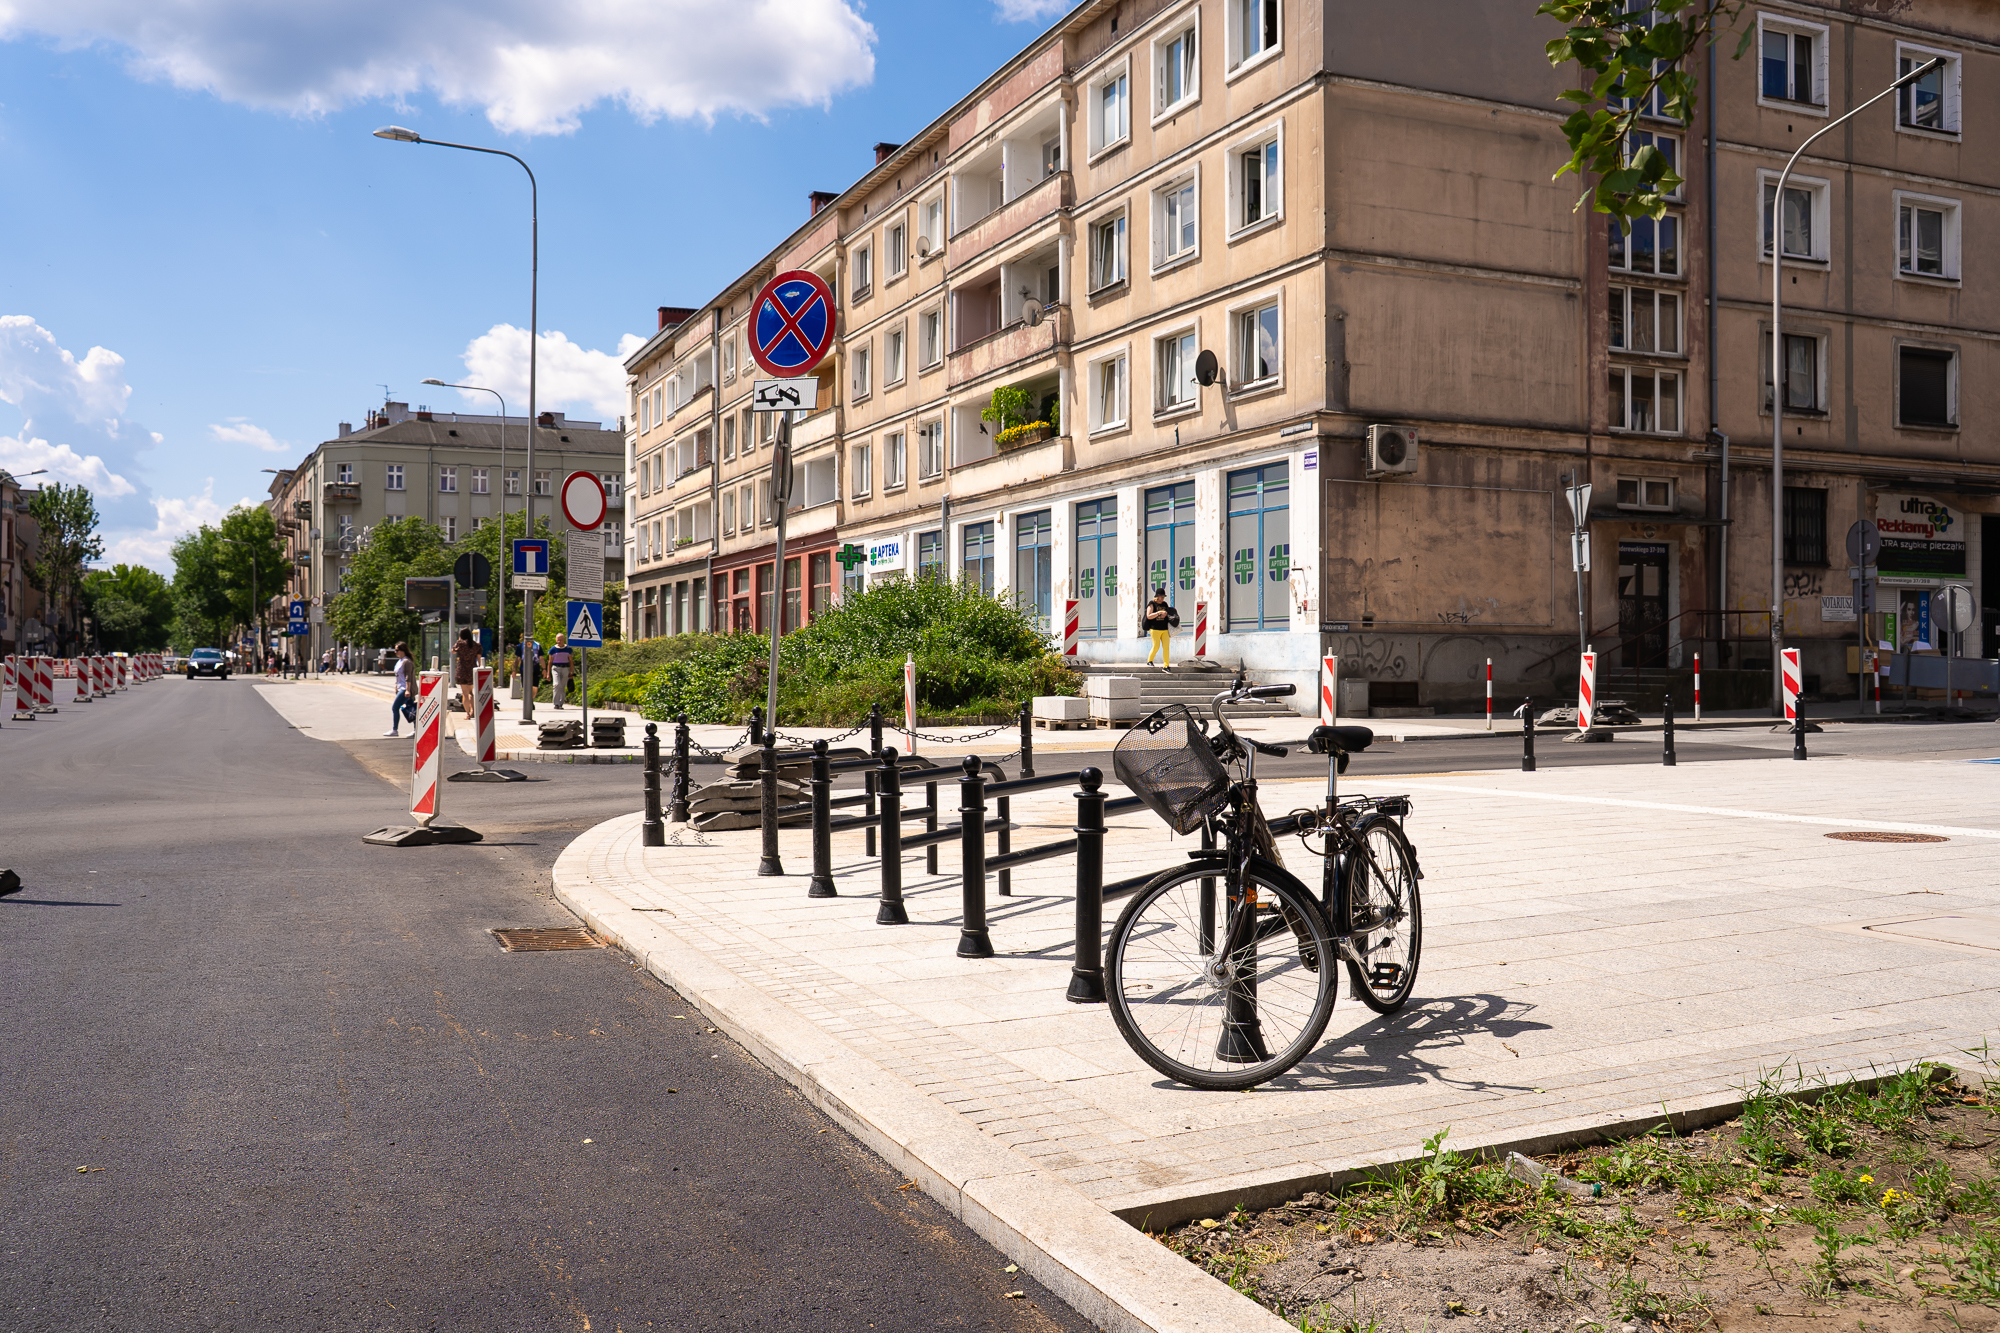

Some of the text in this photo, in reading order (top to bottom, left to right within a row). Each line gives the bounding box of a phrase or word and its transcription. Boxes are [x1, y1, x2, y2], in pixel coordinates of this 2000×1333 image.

[1900, 497, 1937, 515] ultra
[1877, 518, 1935, 538] Reklamy
[877, 542, 900, 559] APTEKA
[1880, 539, 1899, 548] LTRA
[1900, 541, 1928, 551] szybkie
[1236, 563, 1252, 571] APTEKA
[1271, 559, 1288, 568] APTEKA
[1821, 596, 1853, 609] NOTARIUSZ
